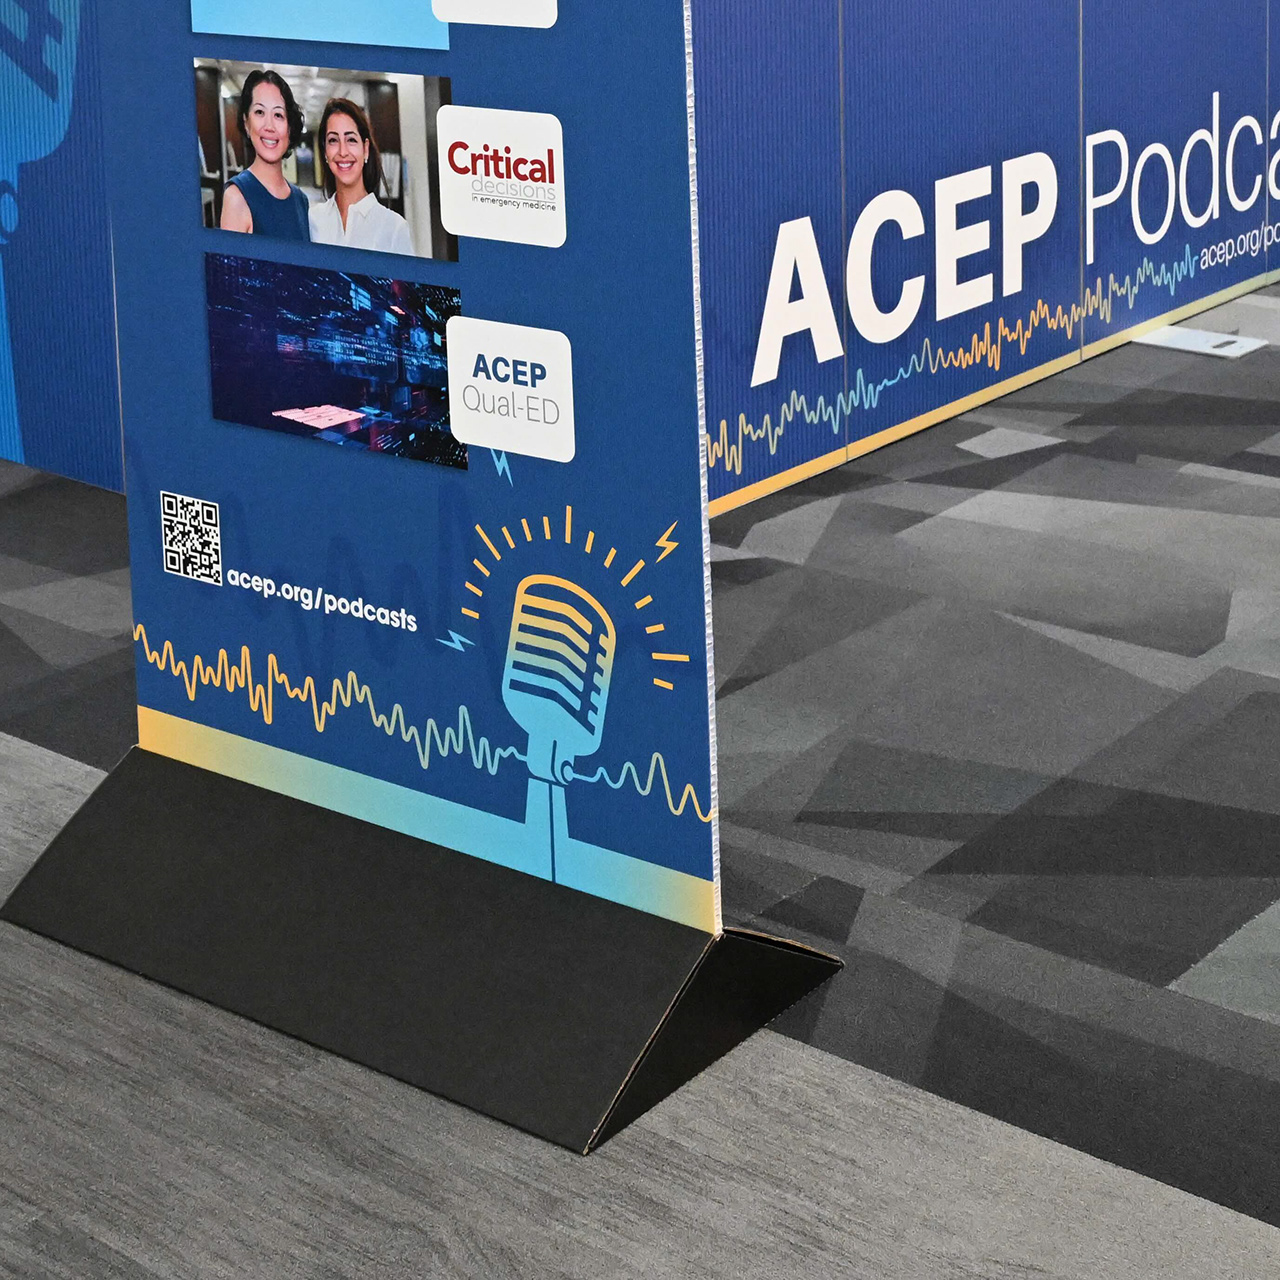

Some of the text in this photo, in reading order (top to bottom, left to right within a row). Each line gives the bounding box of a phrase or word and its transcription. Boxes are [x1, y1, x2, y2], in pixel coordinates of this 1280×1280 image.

[448, 141, 555, 184] Critical
[471, 174, 556, 201] decisions
[480, 196, 521, 209] emergency
[522, 200, 556, 211] medicine
[750, 150, 1060, 389] ACEP
[472, 353, 547, 388] ACEP
[462, 384, 560, 426] Qual-ED
[227, 568, 418, 632] acep.org/podcasts
